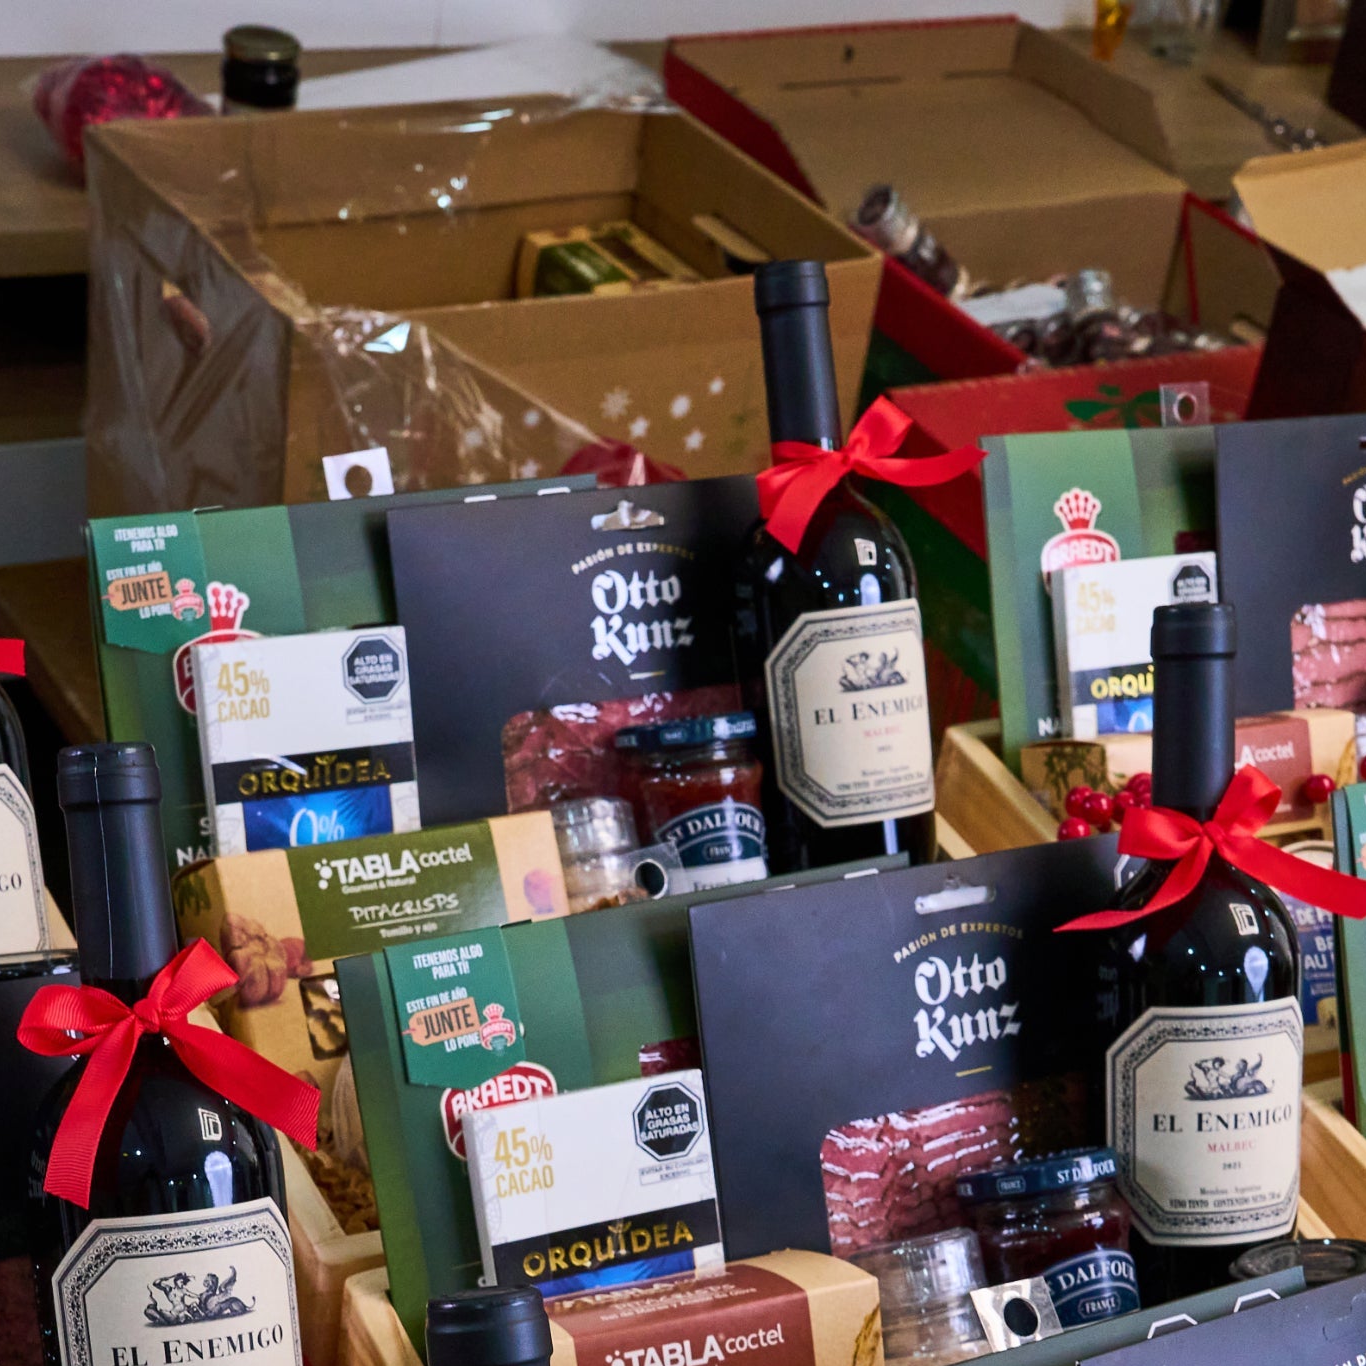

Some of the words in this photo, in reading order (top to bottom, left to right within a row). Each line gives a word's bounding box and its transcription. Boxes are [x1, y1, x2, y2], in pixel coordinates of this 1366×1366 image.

[120, 578, 168, 604] JUNTE
[592, 569, 680, 615] Otto
[591, 614, 694, 666] Kunz
[217, 660, 270, 697] 45%
[218, 698, 270, 722] CACAO
[330, 852, 420, 888] TABLA
[421, 844, 473, 869] coctel
[349, 890, 459, 922] PITACRISPS
[915, 952, 1007, 1006] Otto
[423, 1005, 472, 1038] JUNTE
[914, 1001, 1022, 1062] Kunz
[1153, 1114, 1183, 1133] EL
[1195, 1103, 1293, 1132] ENEMIGO
[494, 1127, 553, 1170] 45%
[496, 1165, 555, 1200] CACAO
[162, 1324, 284, 1366] ENEMIGO
[725, 1324, 785, 1354] coctel
